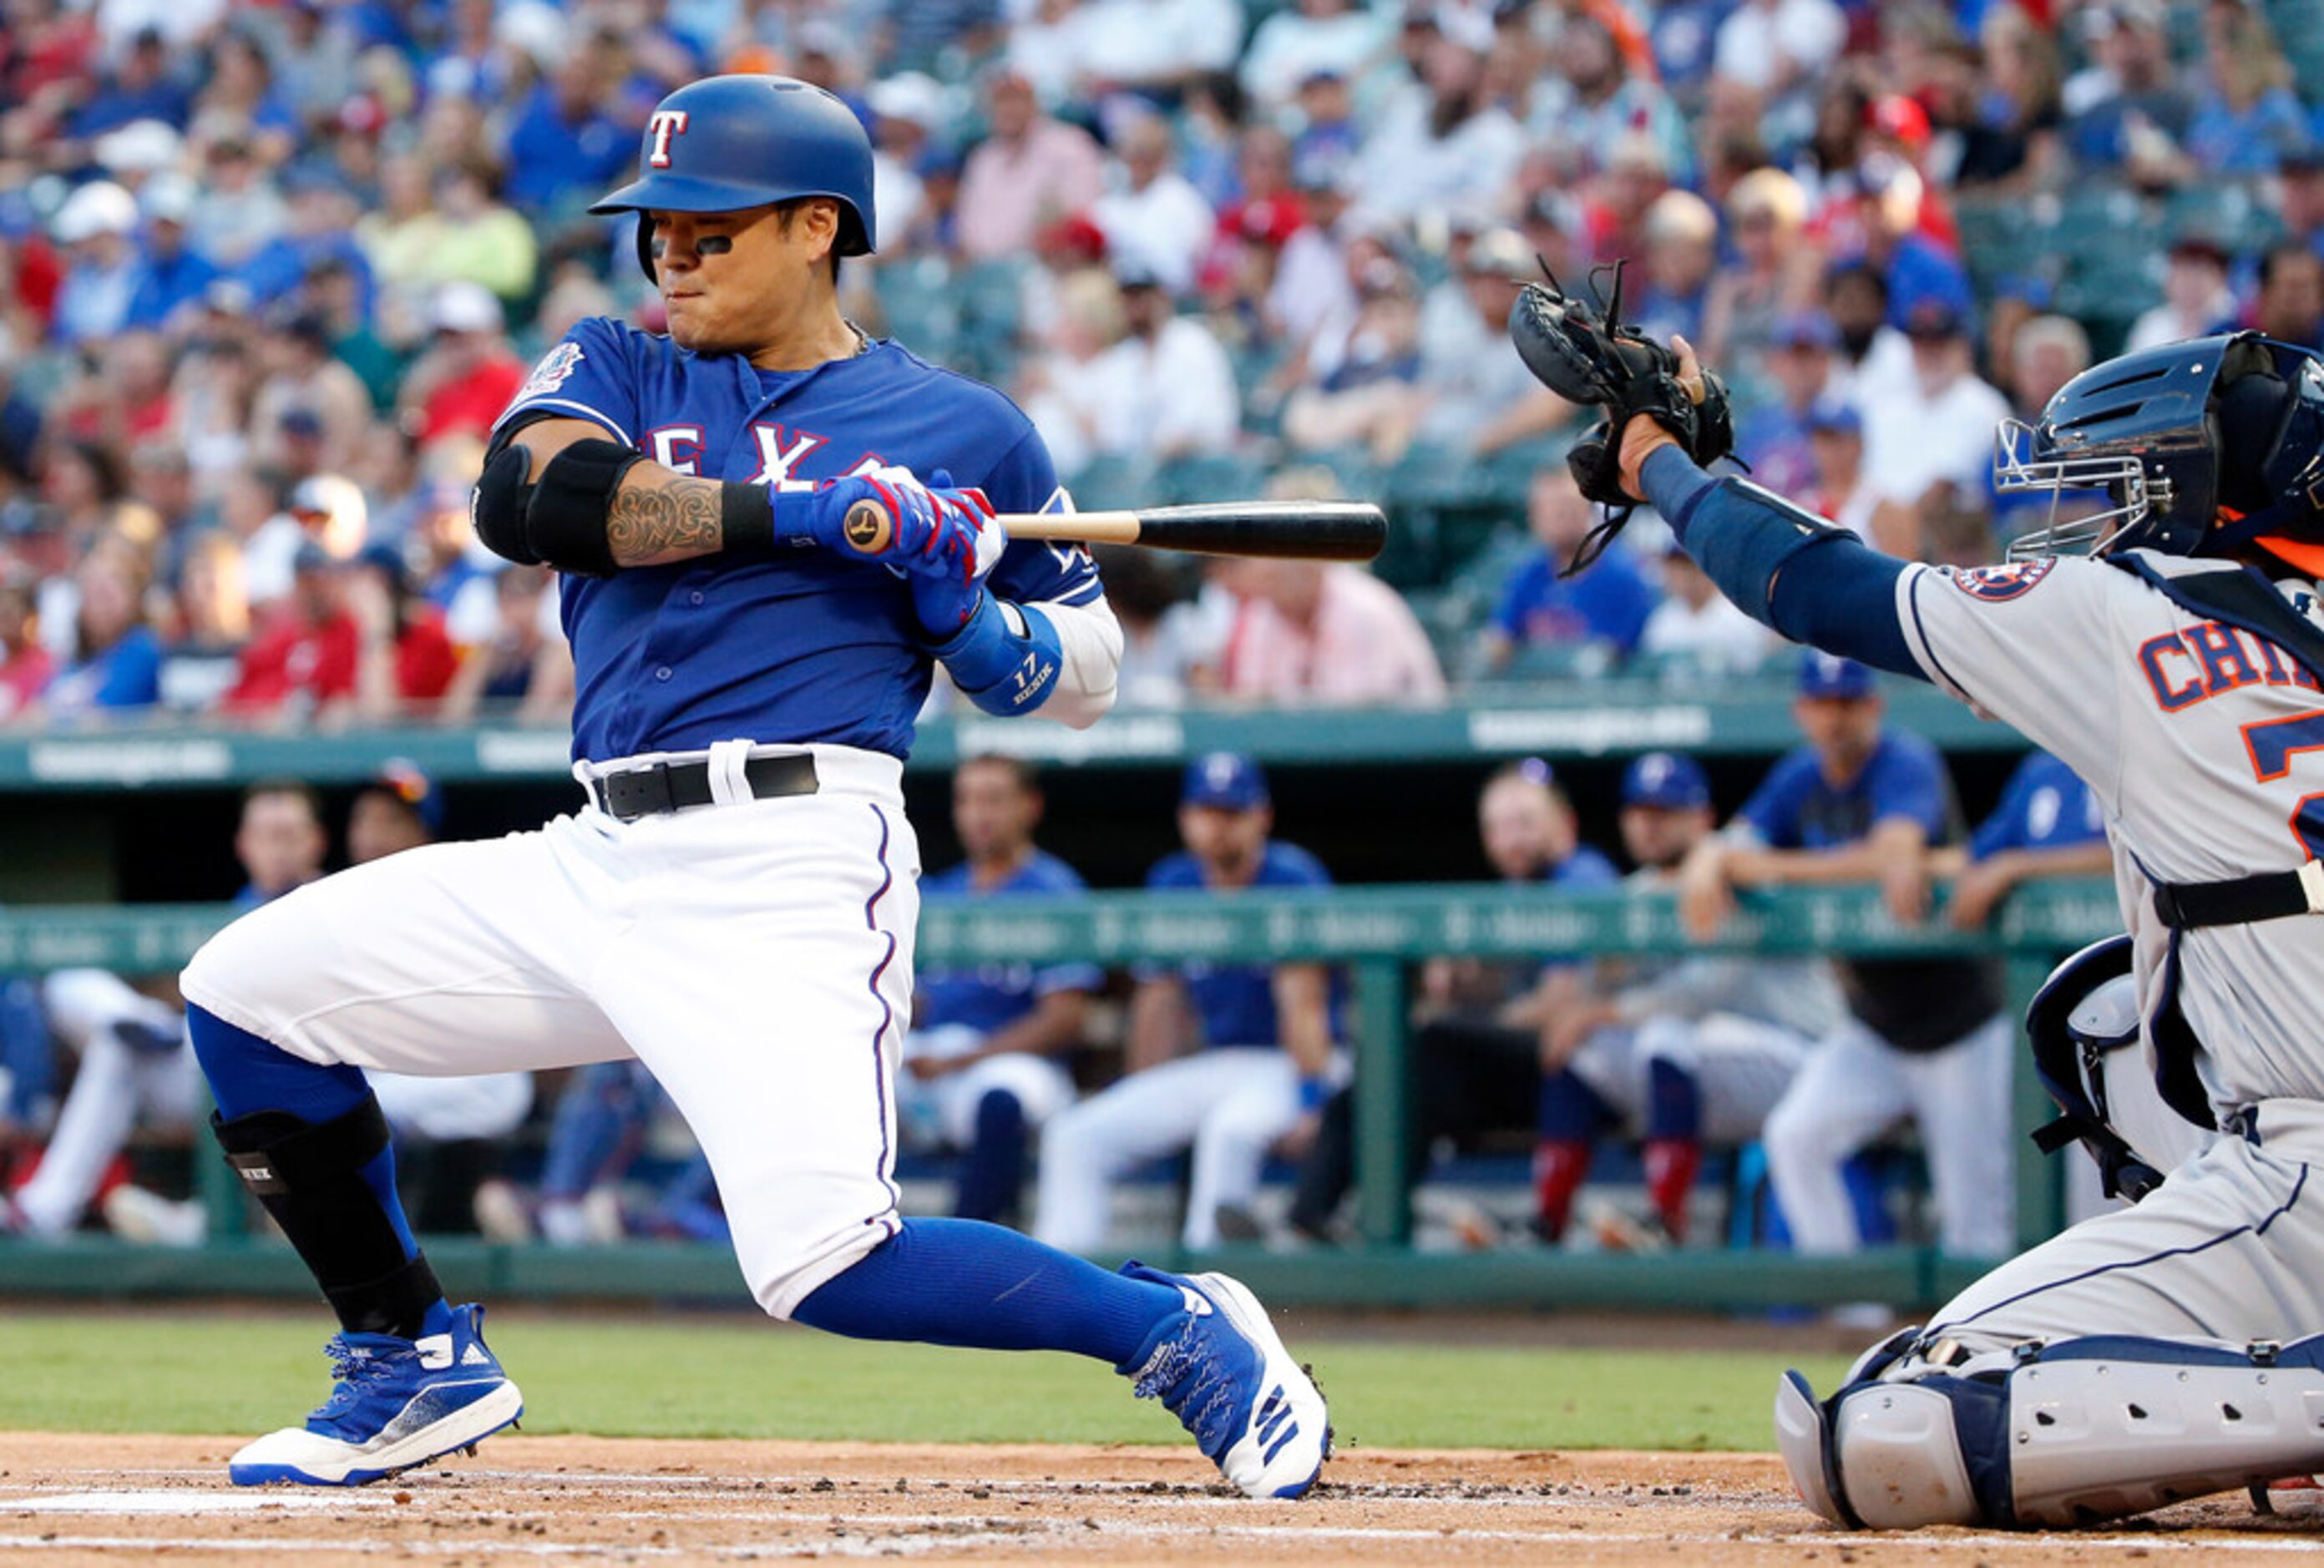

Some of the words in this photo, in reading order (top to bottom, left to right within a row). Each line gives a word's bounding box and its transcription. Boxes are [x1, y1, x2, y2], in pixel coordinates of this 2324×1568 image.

[650, 110, 689, 169] T
[1014, 651, 1036, 688] 17
[2138, 620, 2324, 713] CHI
